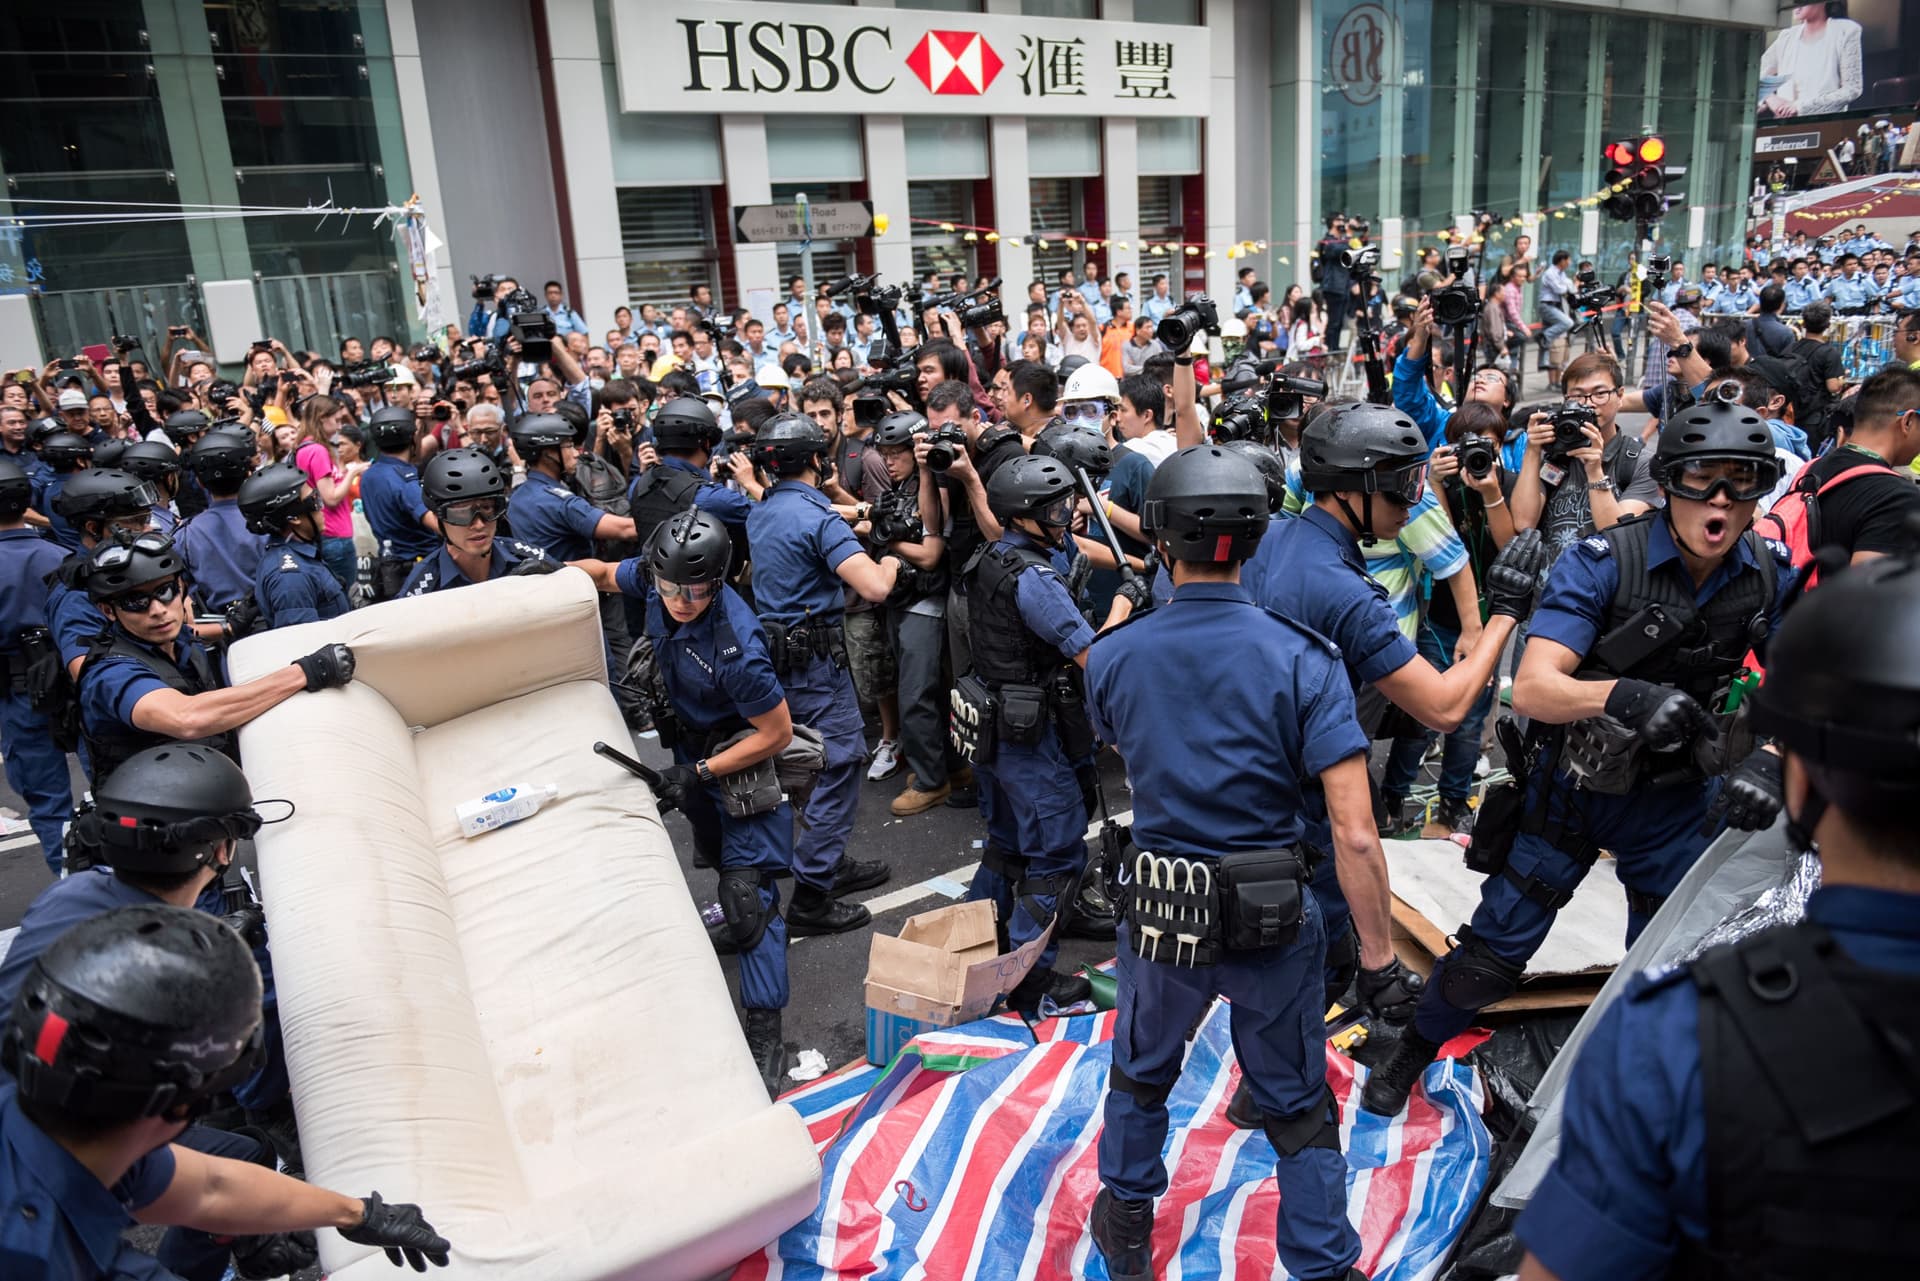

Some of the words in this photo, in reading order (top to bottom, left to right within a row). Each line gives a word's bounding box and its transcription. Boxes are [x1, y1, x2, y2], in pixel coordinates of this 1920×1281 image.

[676, 19, 896, 95] HSBC
[1763, 139, 1809, 151] Preferred
[811, 207, 837, 217] Road
